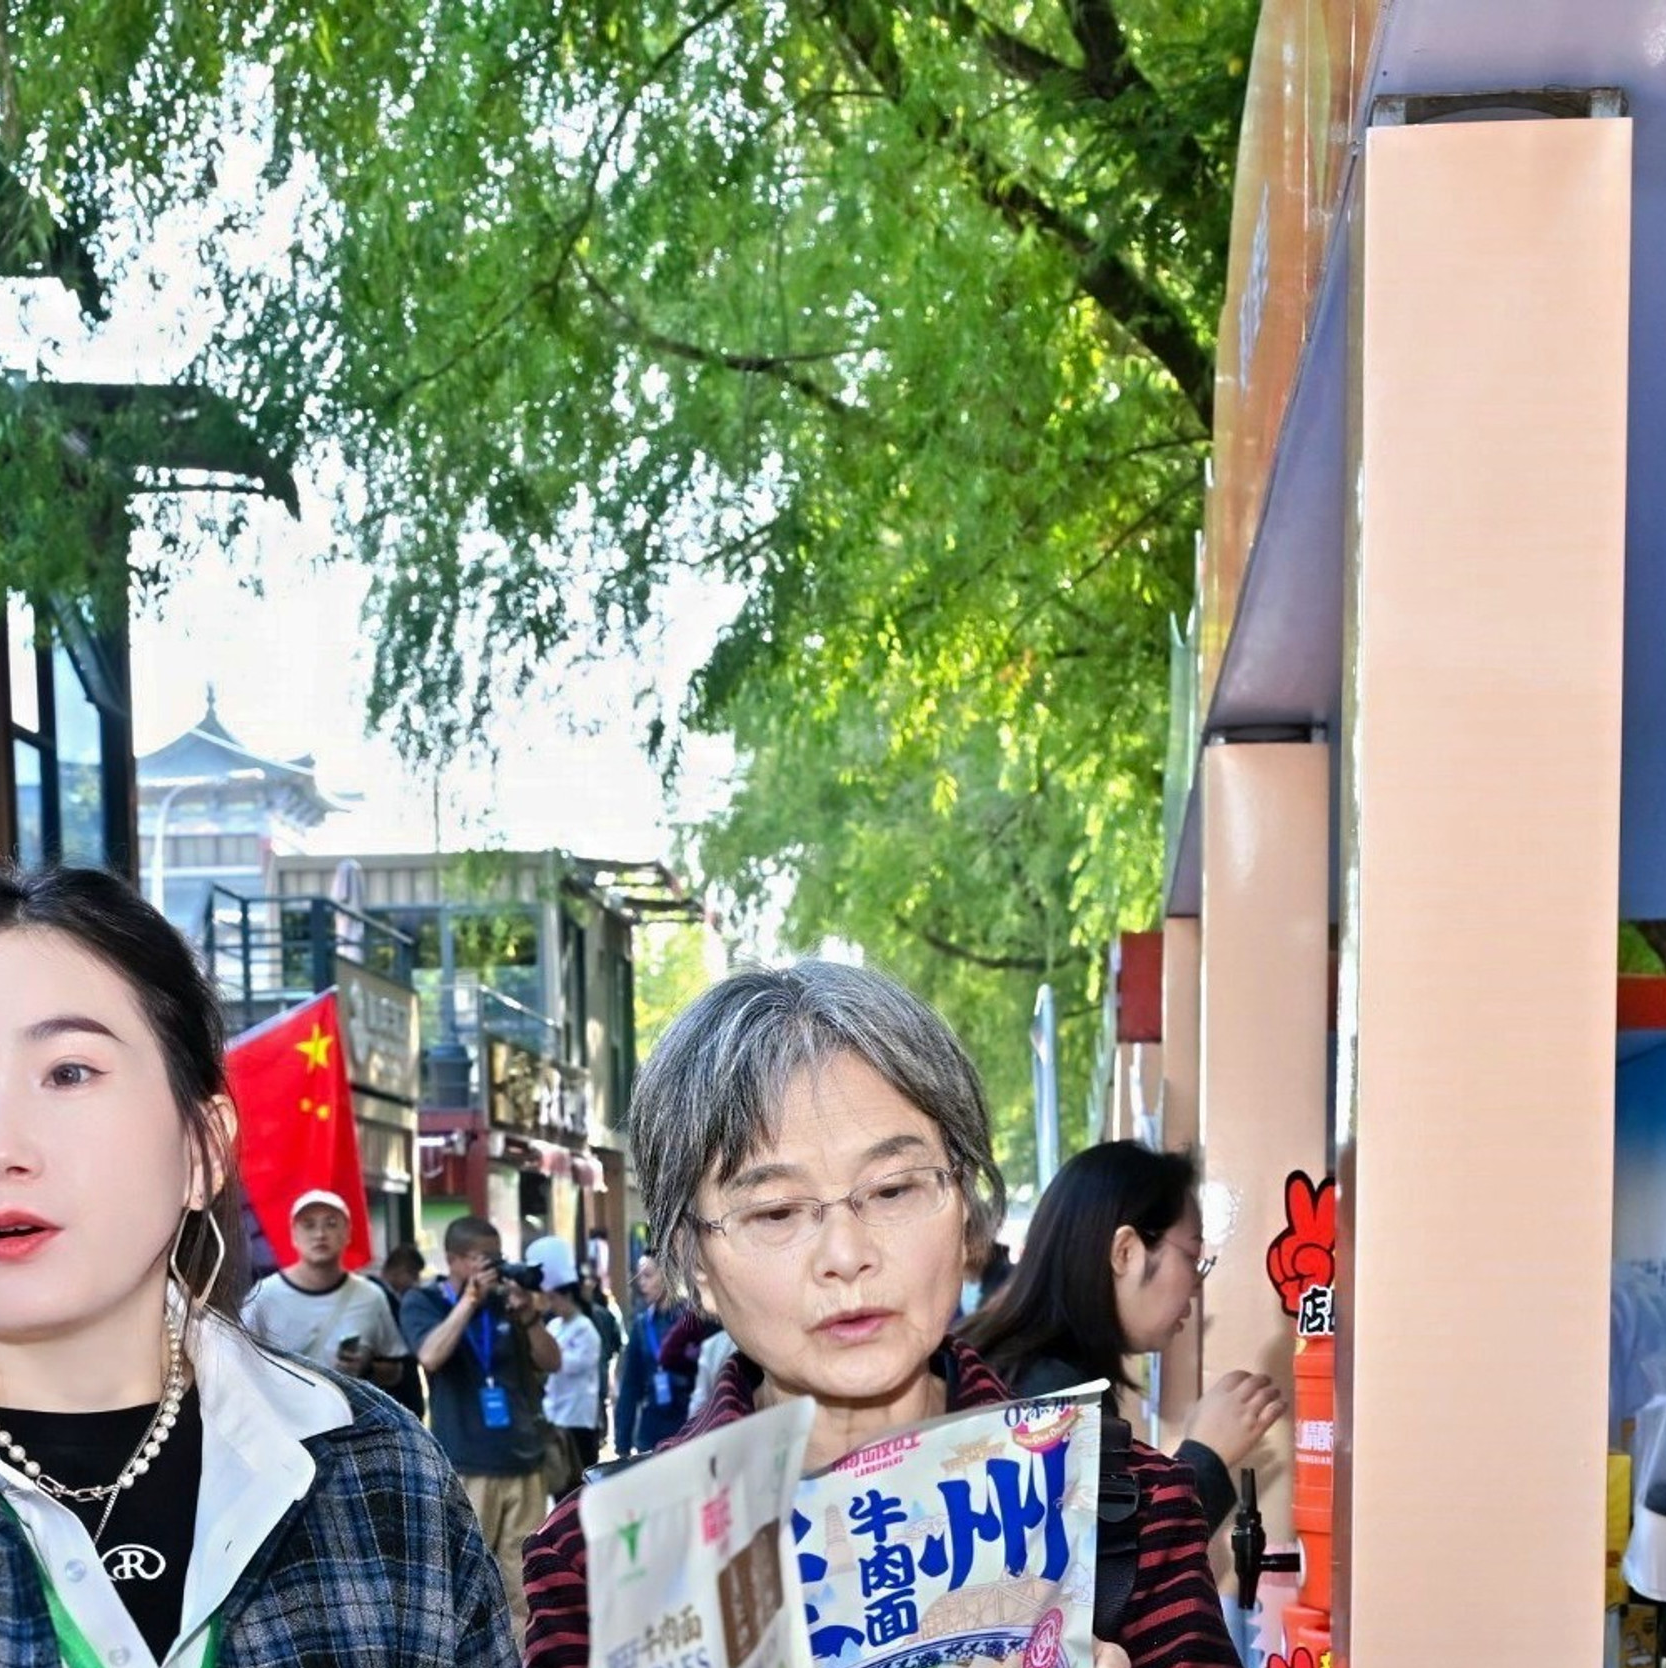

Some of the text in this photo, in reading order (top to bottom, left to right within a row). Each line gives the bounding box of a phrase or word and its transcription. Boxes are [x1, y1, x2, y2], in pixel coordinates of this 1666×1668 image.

[1297, 1286, 1335, 1335] 店
[848, 1489, 919, 1648] 牛肉面
